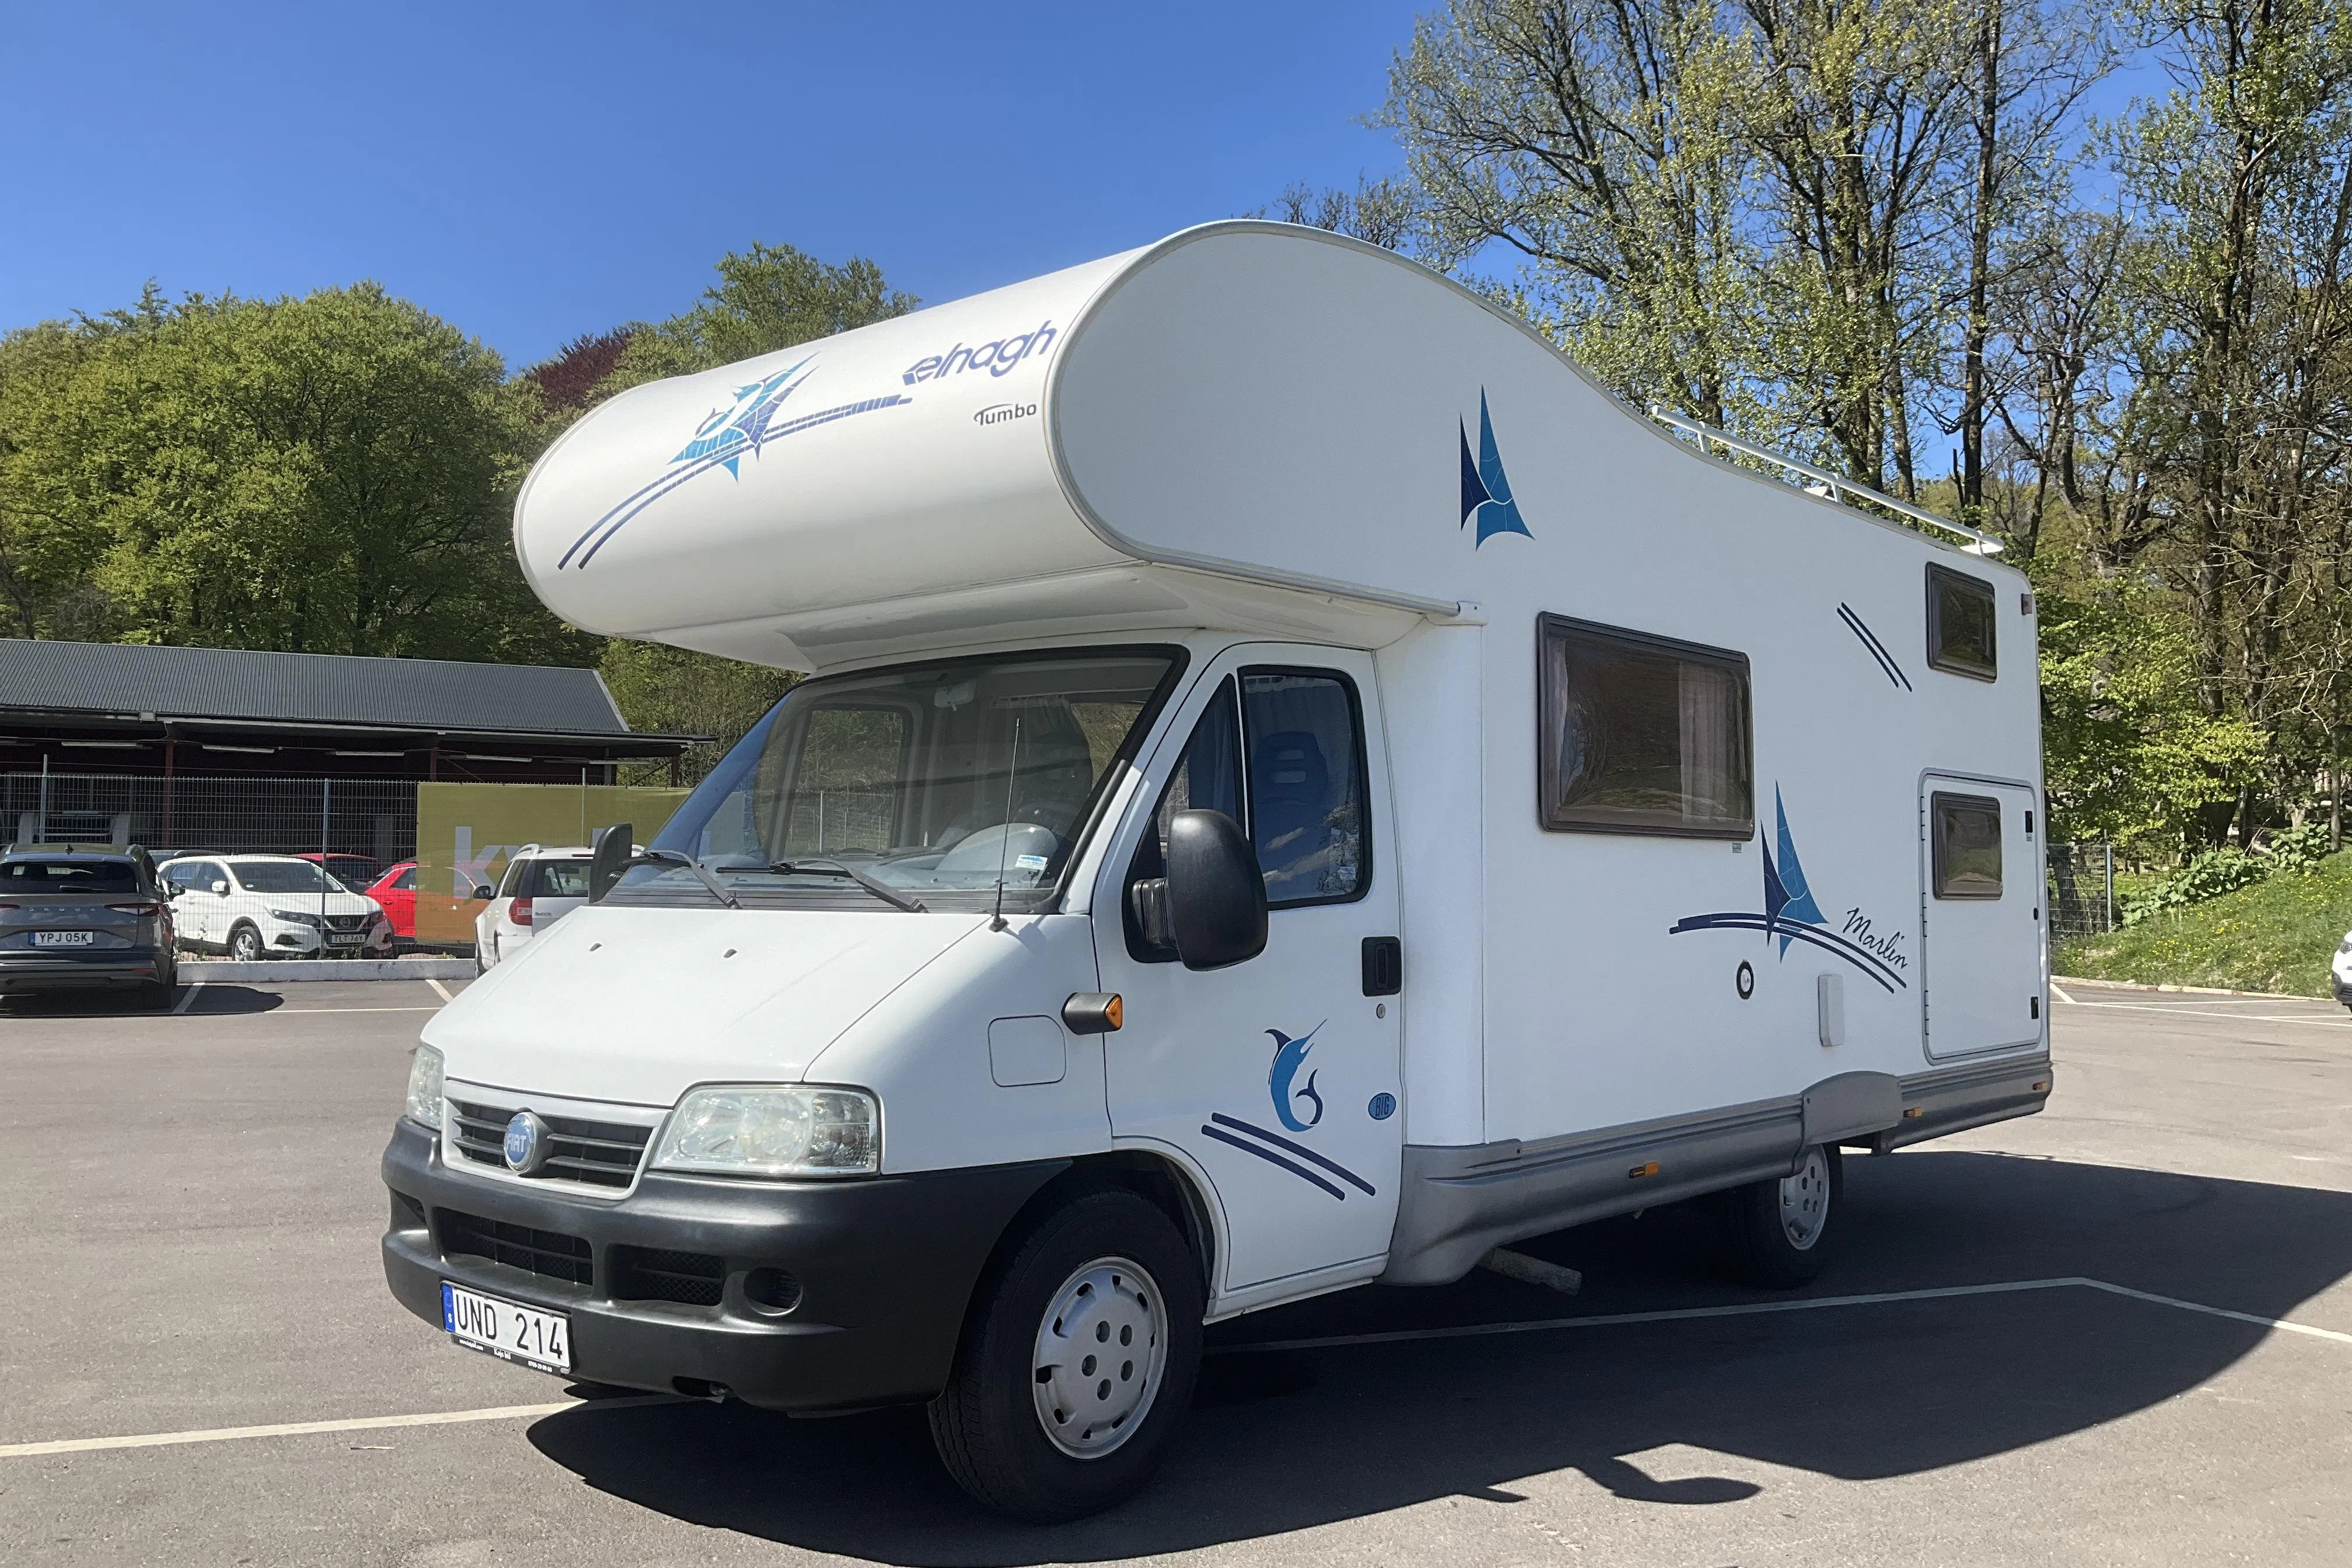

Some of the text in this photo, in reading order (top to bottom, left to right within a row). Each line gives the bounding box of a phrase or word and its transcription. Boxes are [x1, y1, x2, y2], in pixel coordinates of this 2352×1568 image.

[39, 933, 88, 942] YPJ 05K
[1843, 907, 1908, 970] Marlin
[1375, 1096, 1390, 1116] BIG
[507, 1133, 527, 1153] FIAT
[456, 1294, 563, 1359] UND 214
